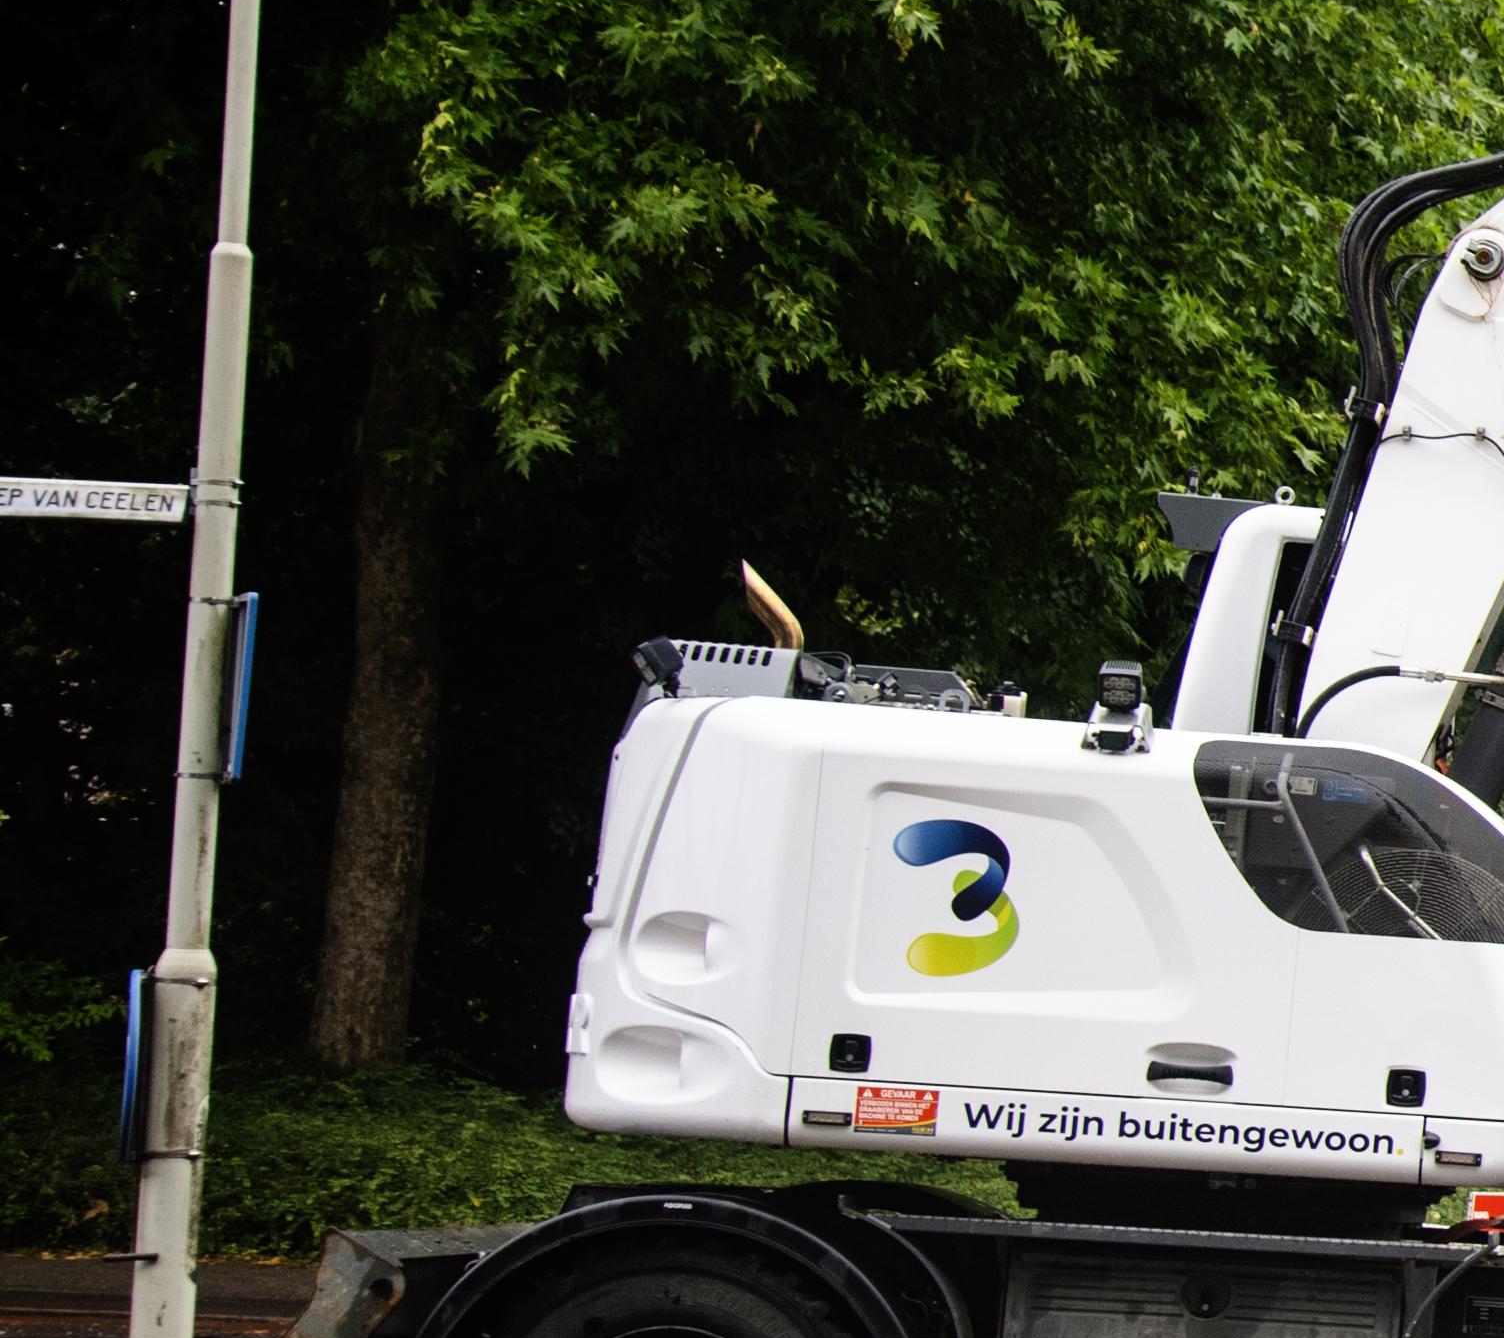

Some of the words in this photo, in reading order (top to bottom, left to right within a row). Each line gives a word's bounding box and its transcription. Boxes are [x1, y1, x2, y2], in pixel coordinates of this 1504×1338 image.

[33, 489, 79, 509] VAN
[85, 491, 176, 512] CEELEN
[880, 1089, 917, 1099] GEVAAR
[963, 1102, 1027, 1138] Wij
[1038, 1106, 1105, 1142] zijn
[1117, 1111, 1405, 1156] buitengewoon.
